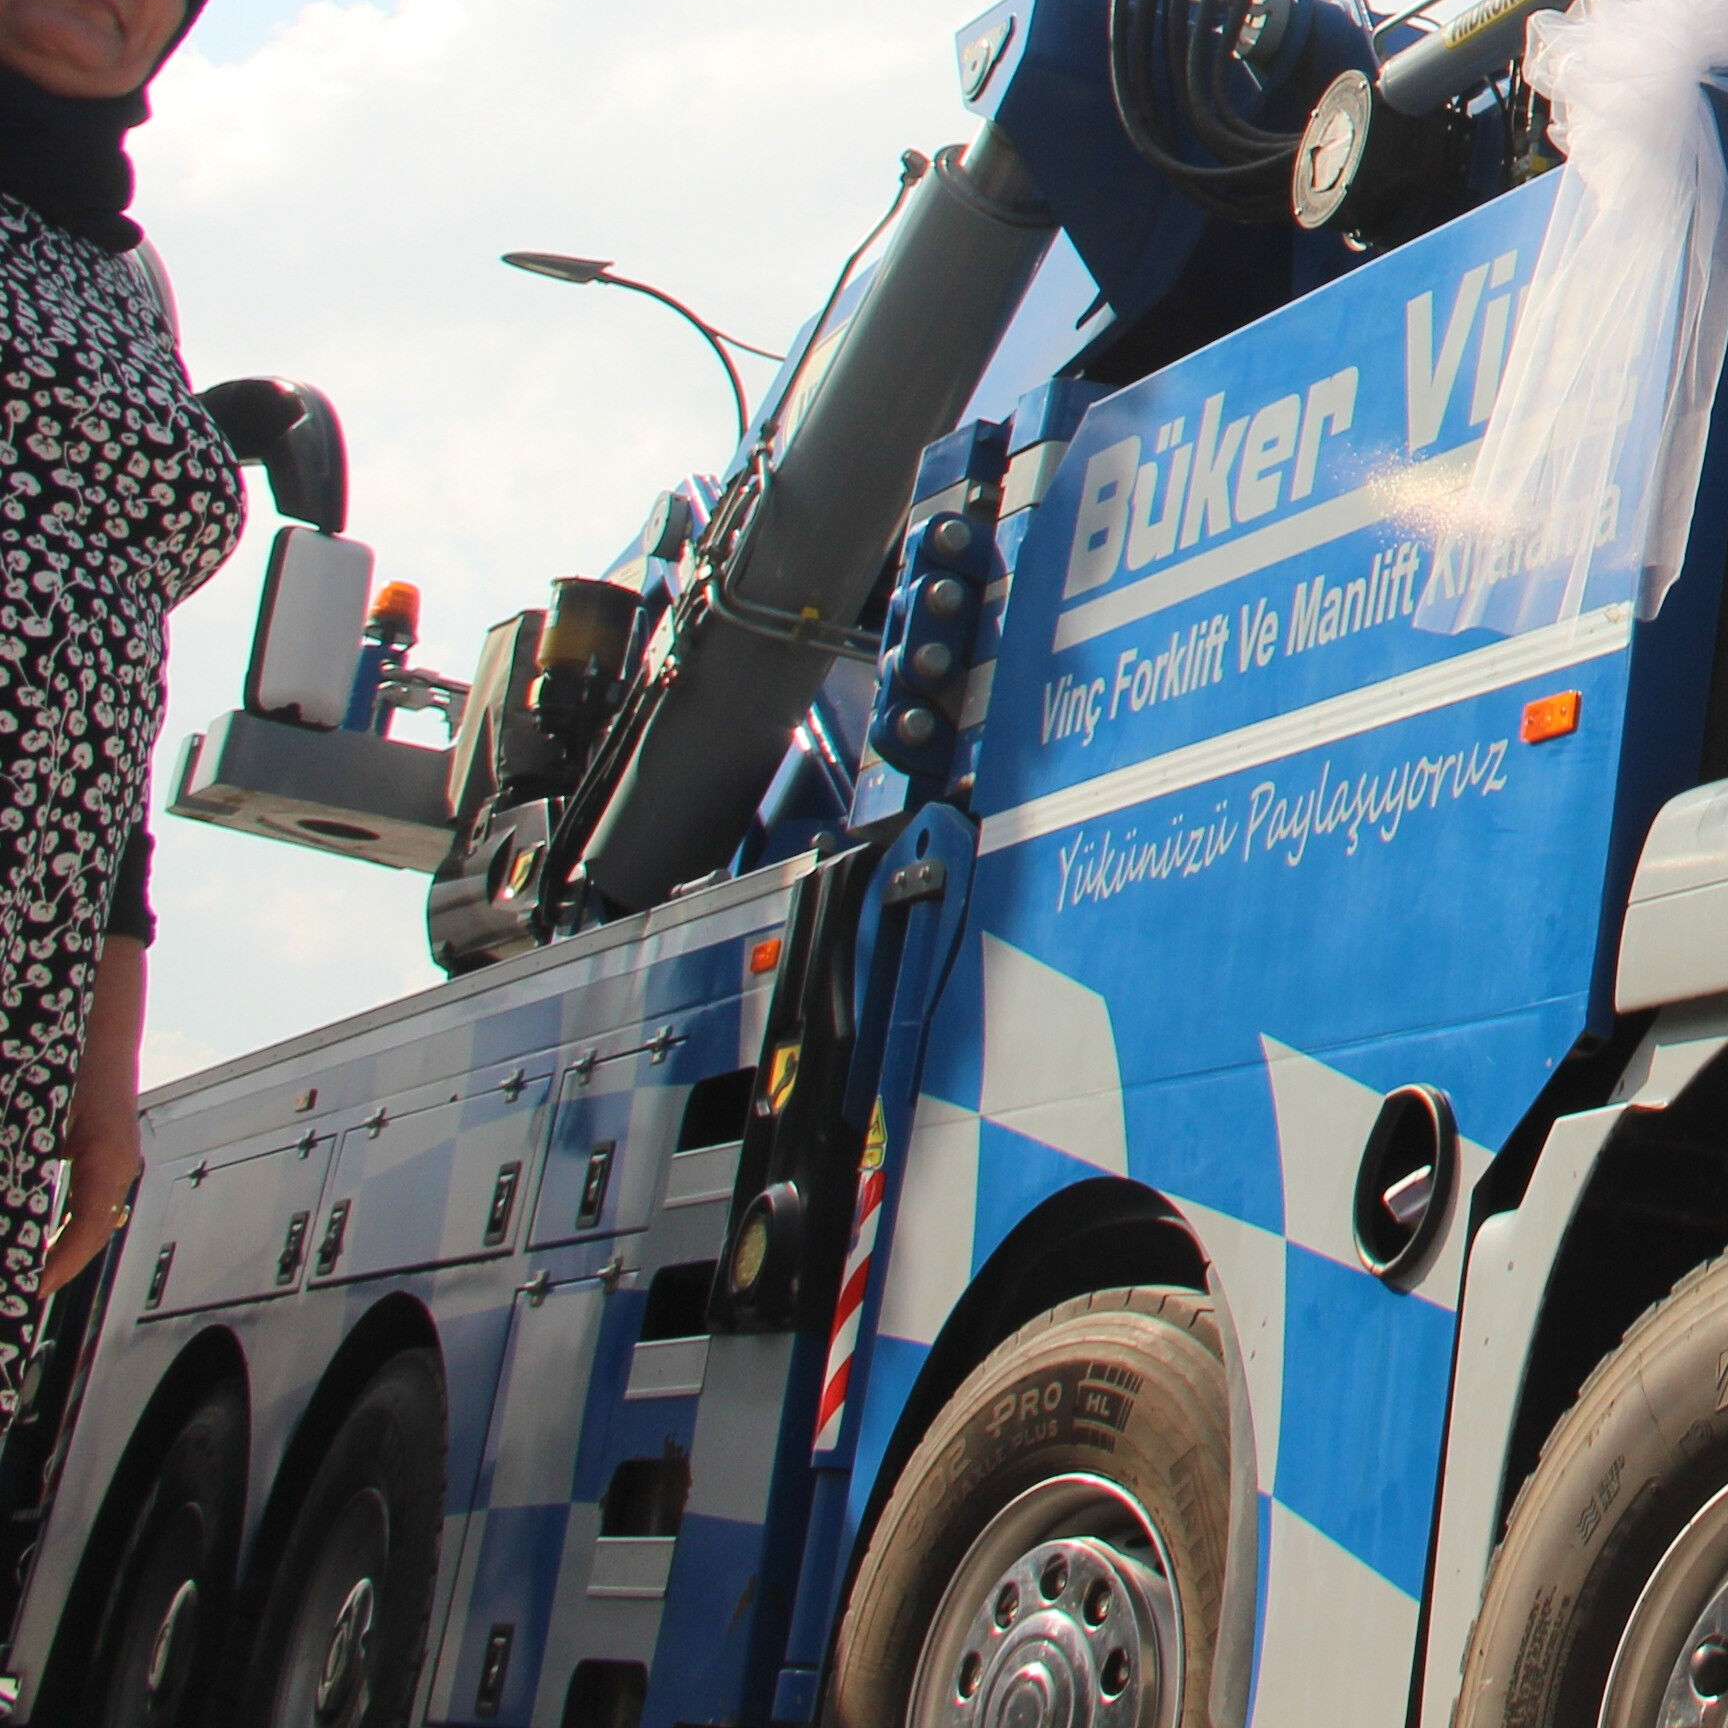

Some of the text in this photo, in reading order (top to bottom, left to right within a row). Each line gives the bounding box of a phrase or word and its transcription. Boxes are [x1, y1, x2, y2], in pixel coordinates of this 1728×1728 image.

[1062, 364, 1359, 601] Büker
[1041, 677, 1104, 747] Vinç
[1112, 611, 1230, 715] Forklift
[1238, 604, 1280, 673] Ve
[1285, 541, 1420, 659] Manlift
[1055, 737, 1509, 912] Yükünüzü Paylaşıyoruz
